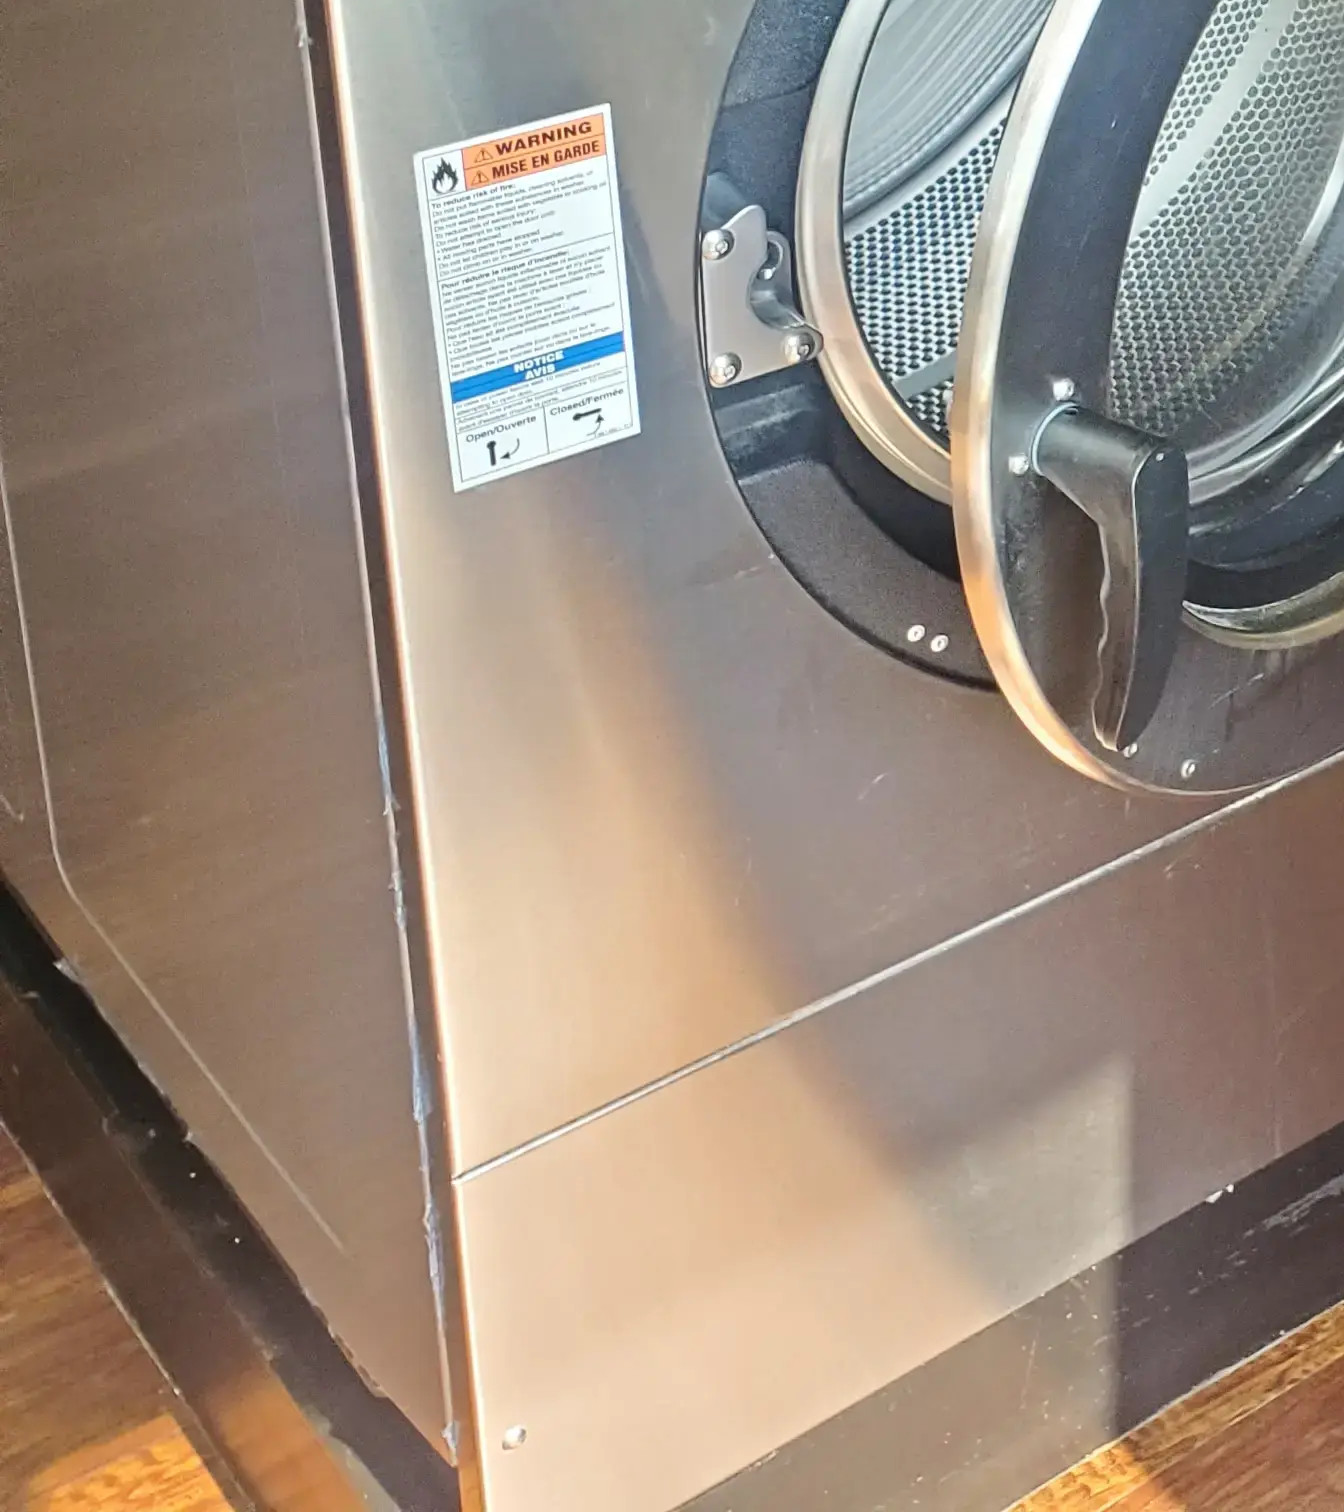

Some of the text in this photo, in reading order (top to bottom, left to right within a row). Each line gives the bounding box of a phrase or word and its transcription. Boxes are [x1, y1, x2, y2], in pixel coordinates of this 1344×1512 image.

[494, 118, 592, 157] WARNING
[491, 138, 600, 180] MISE EN GARDE
[513, 349, 564, 373] NOTICE
[524, 362, 555, 380] AVIS
[549, 385, 623, 418] Closed/Fermée
[465, 413, 537, 445] Open/Ouverte
